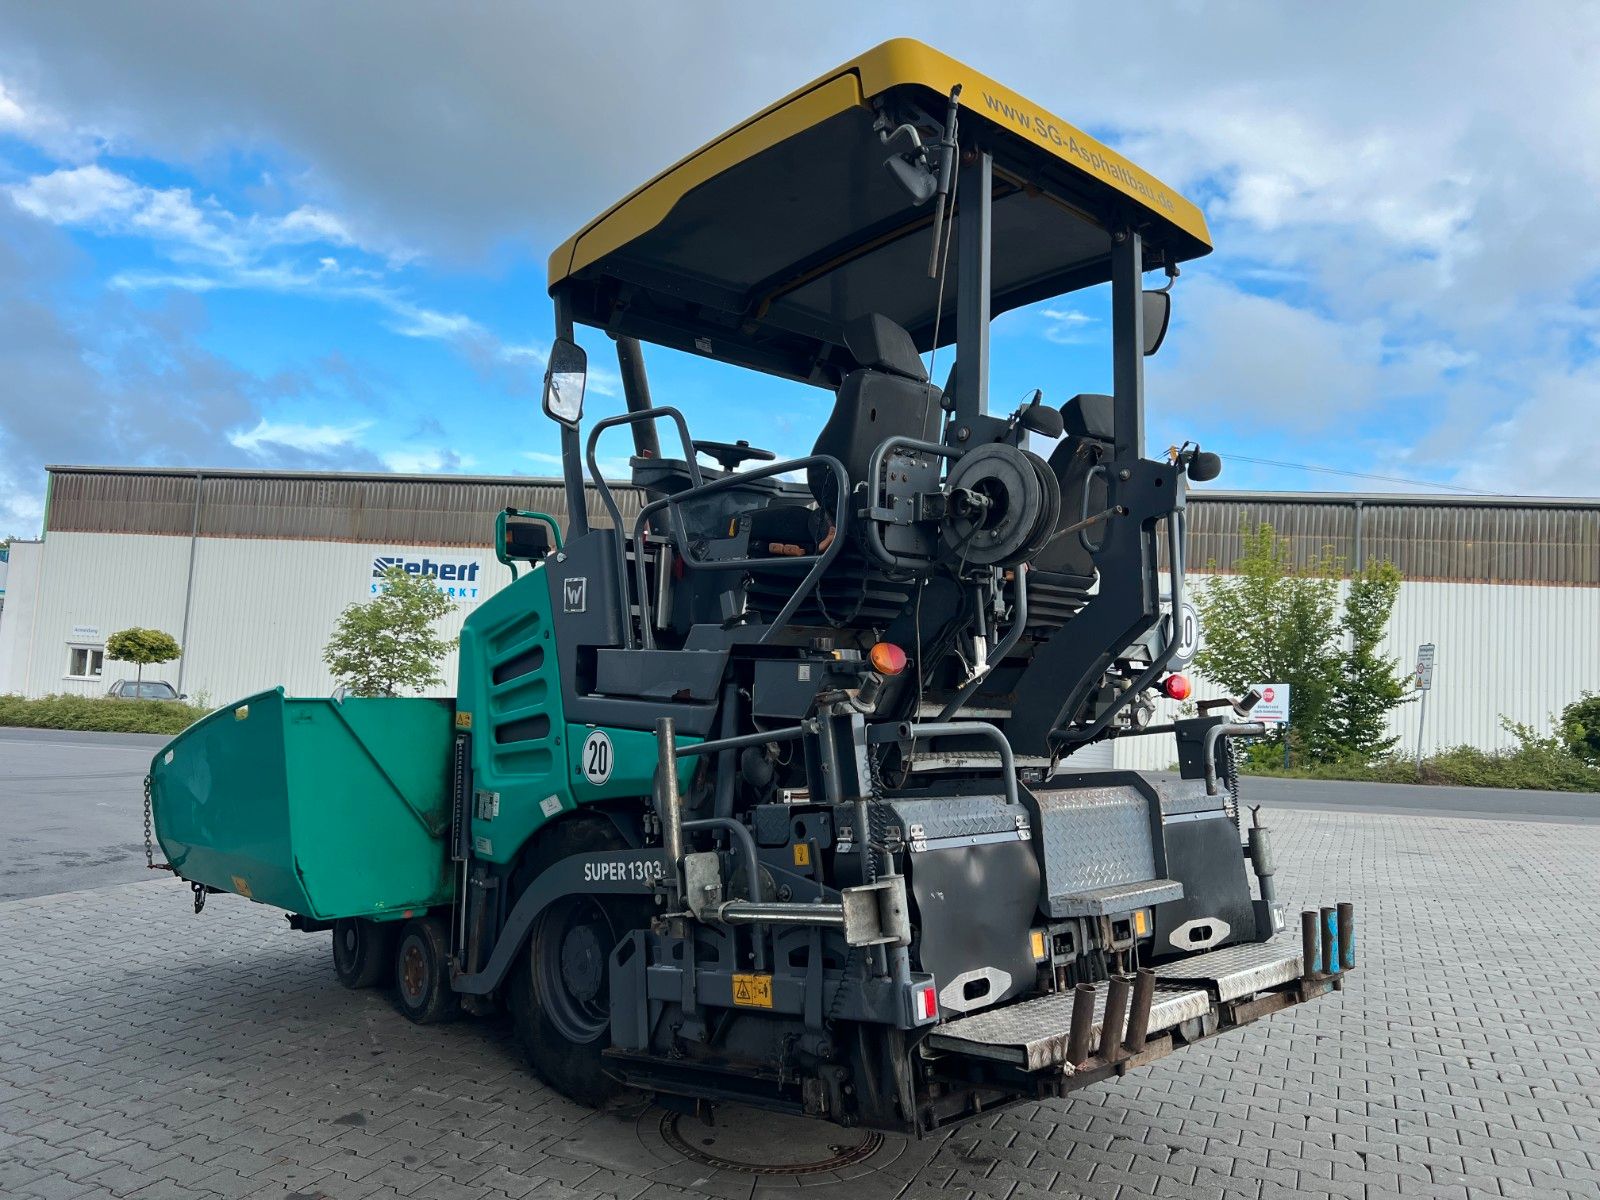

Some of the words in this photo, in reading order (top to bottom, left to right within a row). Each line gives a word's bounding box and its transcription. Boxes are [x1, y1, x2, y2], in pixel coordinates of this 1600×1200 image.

[983, 91, 1175, 213] www.SG-Asphaltbau.de
[373, 557, 479, 581] Siebert
[588, 740, 607, 775] 20
[584, 862, 627, 881] SUPER
